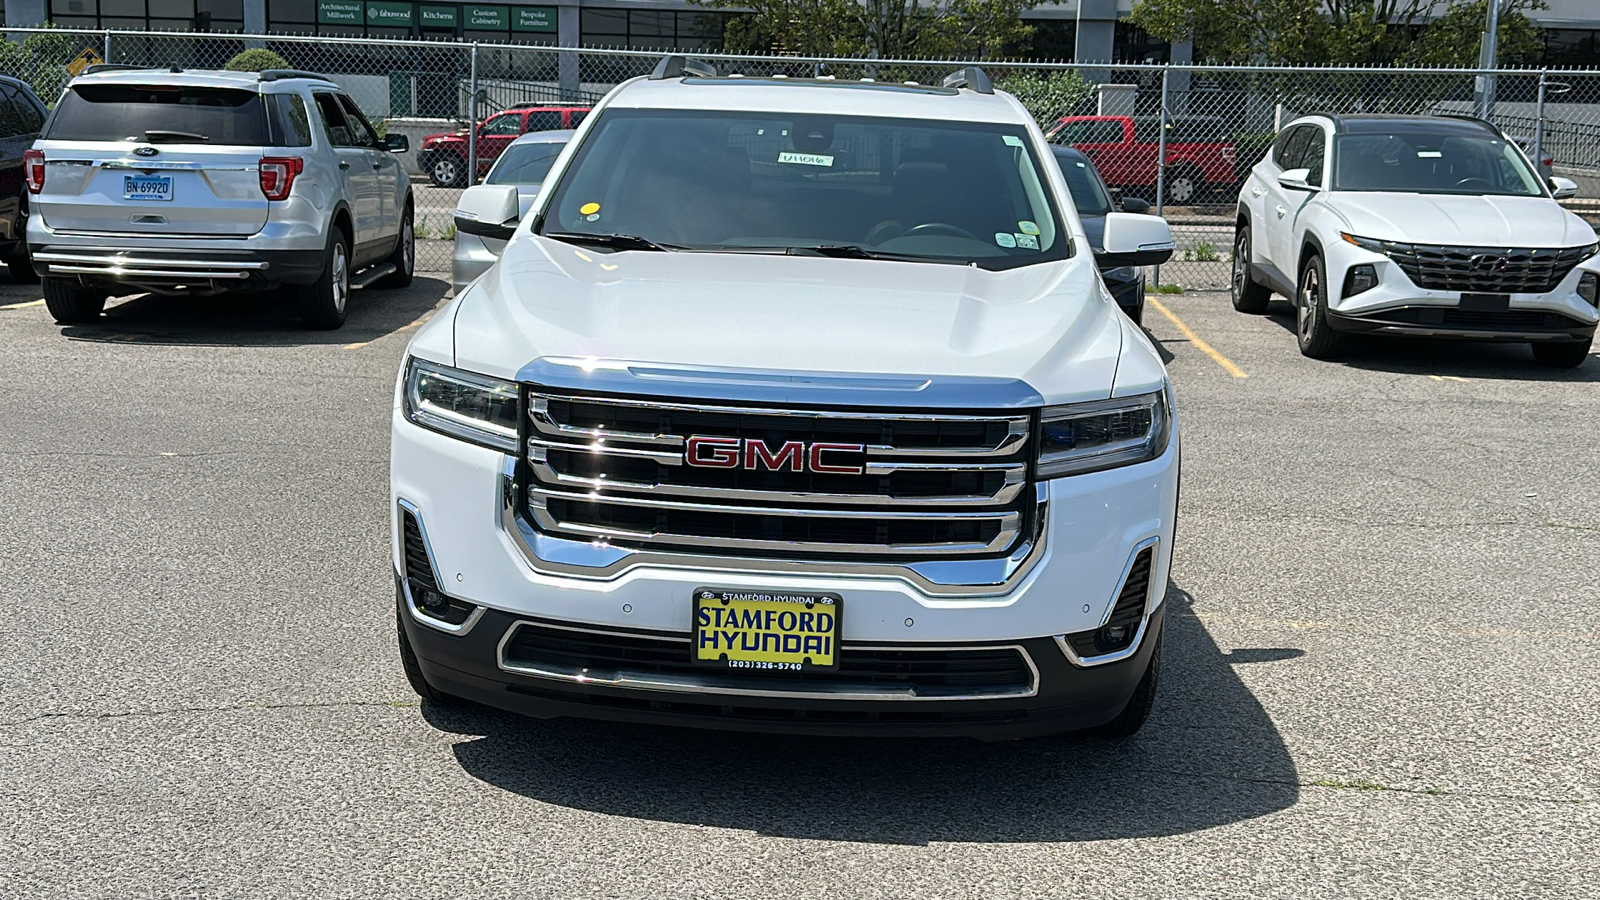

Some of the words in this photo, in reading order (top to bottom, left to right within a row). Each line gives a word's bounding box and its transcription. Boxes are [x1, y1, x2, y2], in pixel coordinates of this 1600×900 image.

[320, 3, 360, 11] Architectural
[326, 11, 356, 19] Millwork
[423, 11, 453, 20] Kitchens
[473, 9, 498, 17] Custom
[520, 11, 546, 19] Bespoke
[471, 17, 501, 26] Cabinetry
[520, 19, 549, 27] Furniture
[685, 434, 865, 475] GMC
[722, 592, 771, 602] STAMFORD
[773, 595, 815, 604] HYUNDAI
[698, 606, 834, 634] STAMFORD
[699, 630, 831, 655] HYUNDAI
